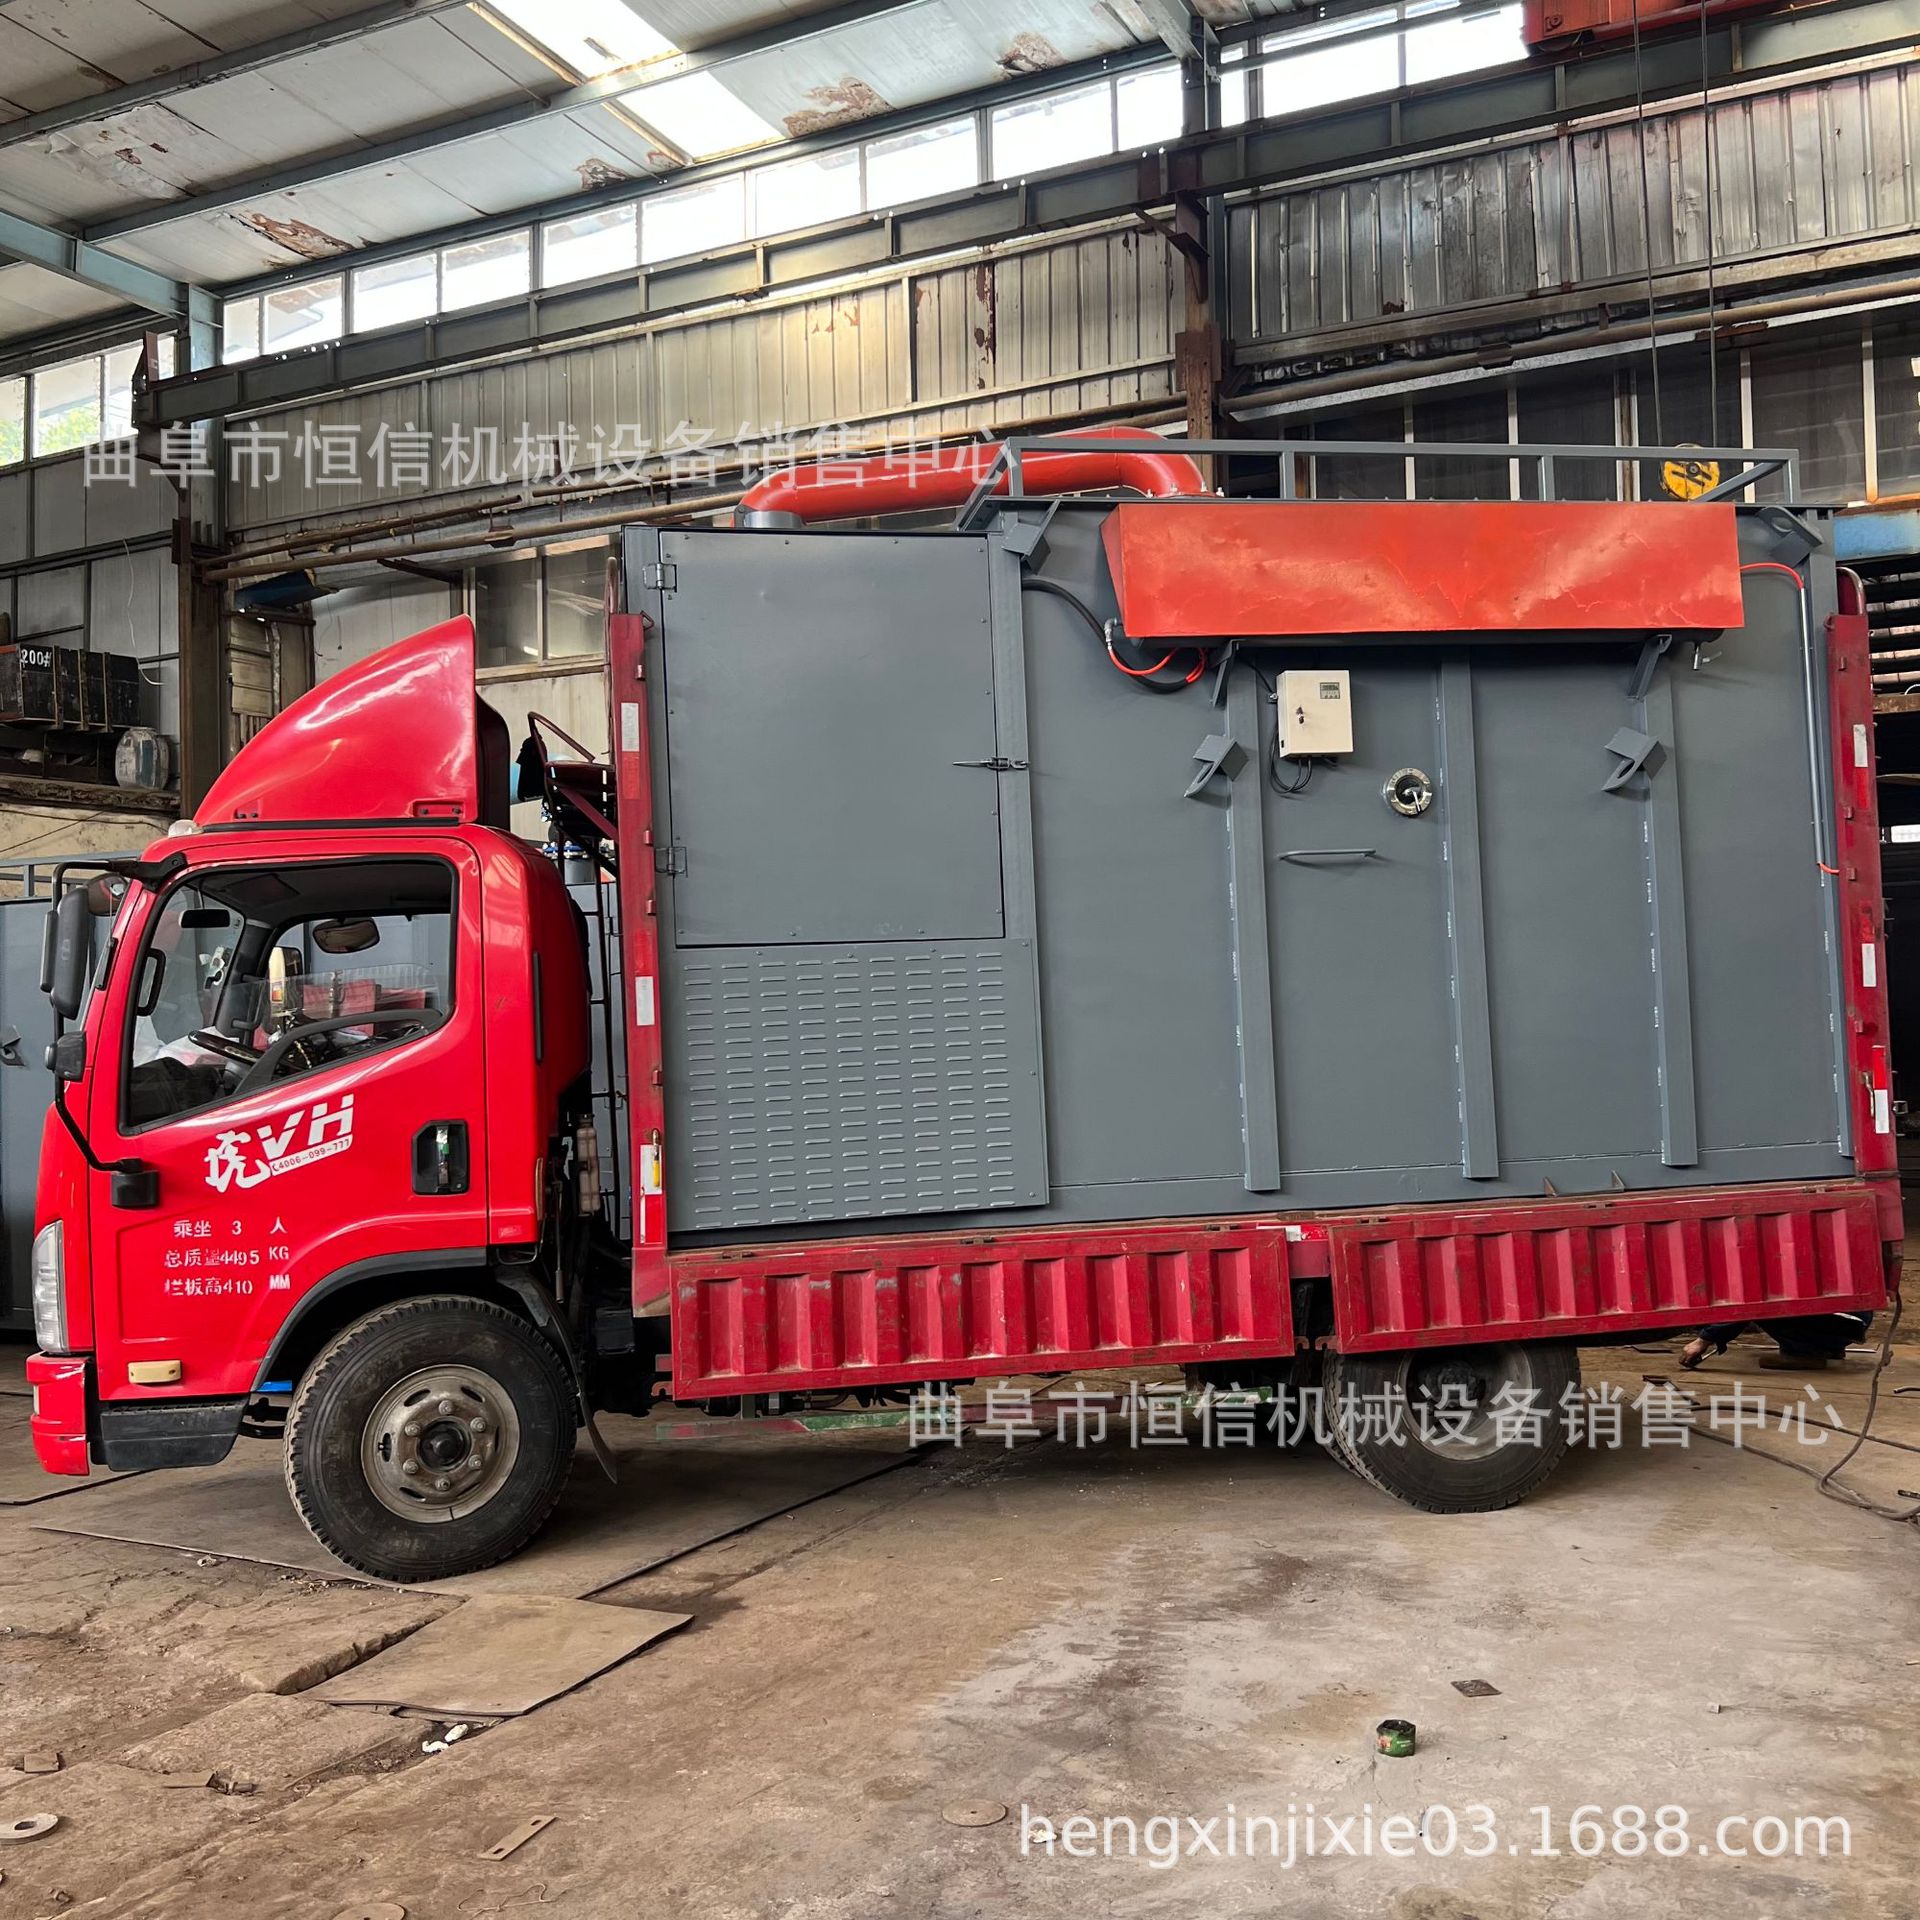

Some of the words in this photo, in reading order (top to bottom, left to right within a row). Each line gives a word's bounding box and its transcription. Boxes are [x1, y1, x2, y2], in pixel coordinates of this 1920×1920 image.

[173, 1219, 212, 1238] 乘坐
[231, 1220, 243, 1236] 3
[269, 1216, 288, 1234] 人
[269, 1246, 289, 1260] KG
[269, 1274, 291, 1290] MM
